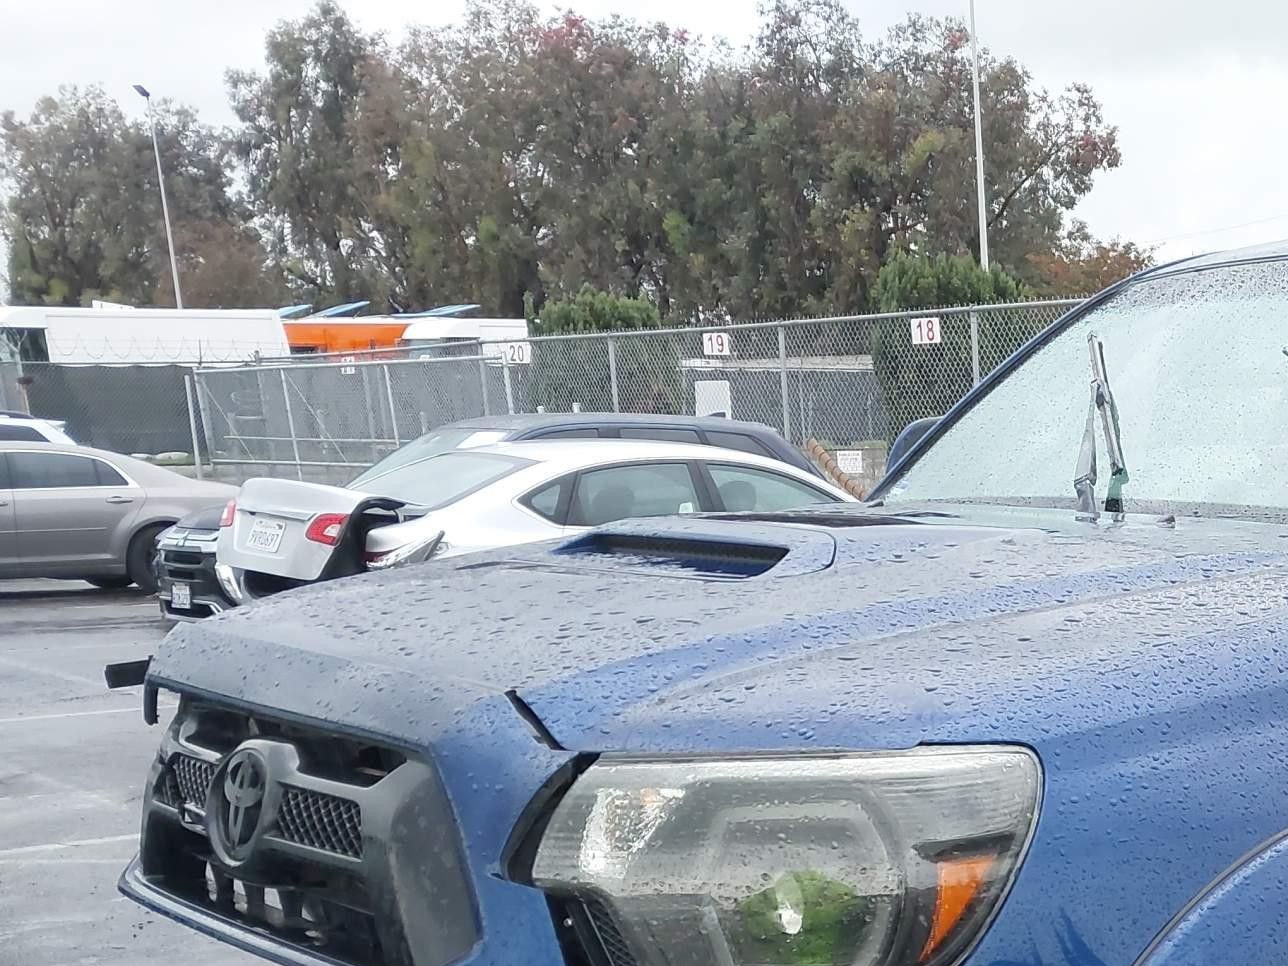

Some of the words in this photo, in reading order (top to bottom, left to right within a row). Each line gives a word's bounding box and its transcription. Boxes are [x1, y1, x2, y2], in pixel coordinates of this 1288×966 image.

[916, 319, 935, 342] 18
[509, 344, 524, 362] 20
[707, 334, 724, 353] 19
